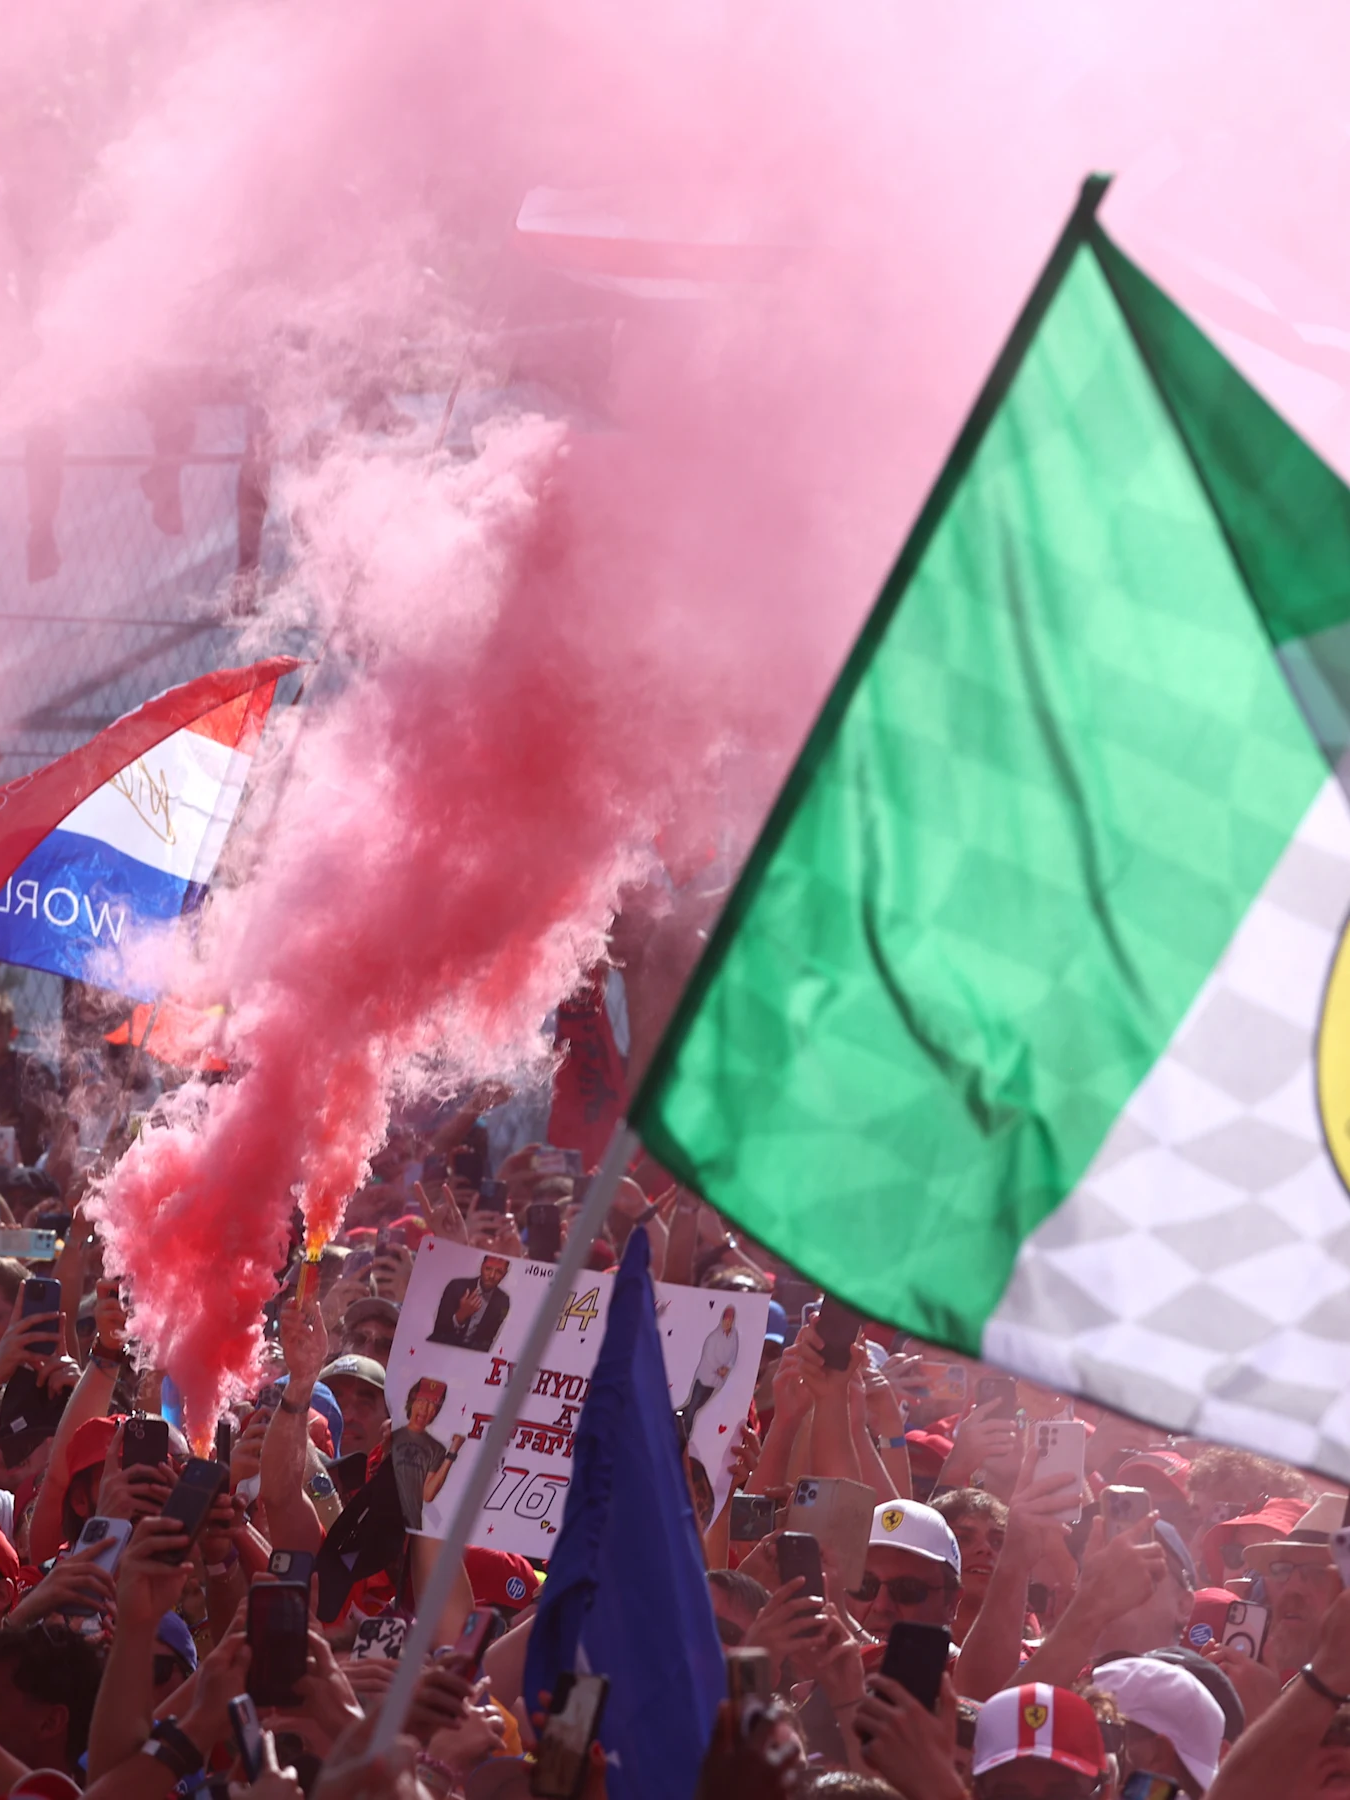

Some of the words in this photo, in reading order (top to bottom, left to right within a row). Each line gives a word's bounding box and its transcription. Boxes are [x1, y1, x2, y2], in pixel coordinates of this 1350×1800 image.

[484, 1356, 592, 1404] ERYO
[552, 1403, 581, 1429] A
[467, 1412, 576, 1459] Frari
[507, 1577, 525, 1599] hp
